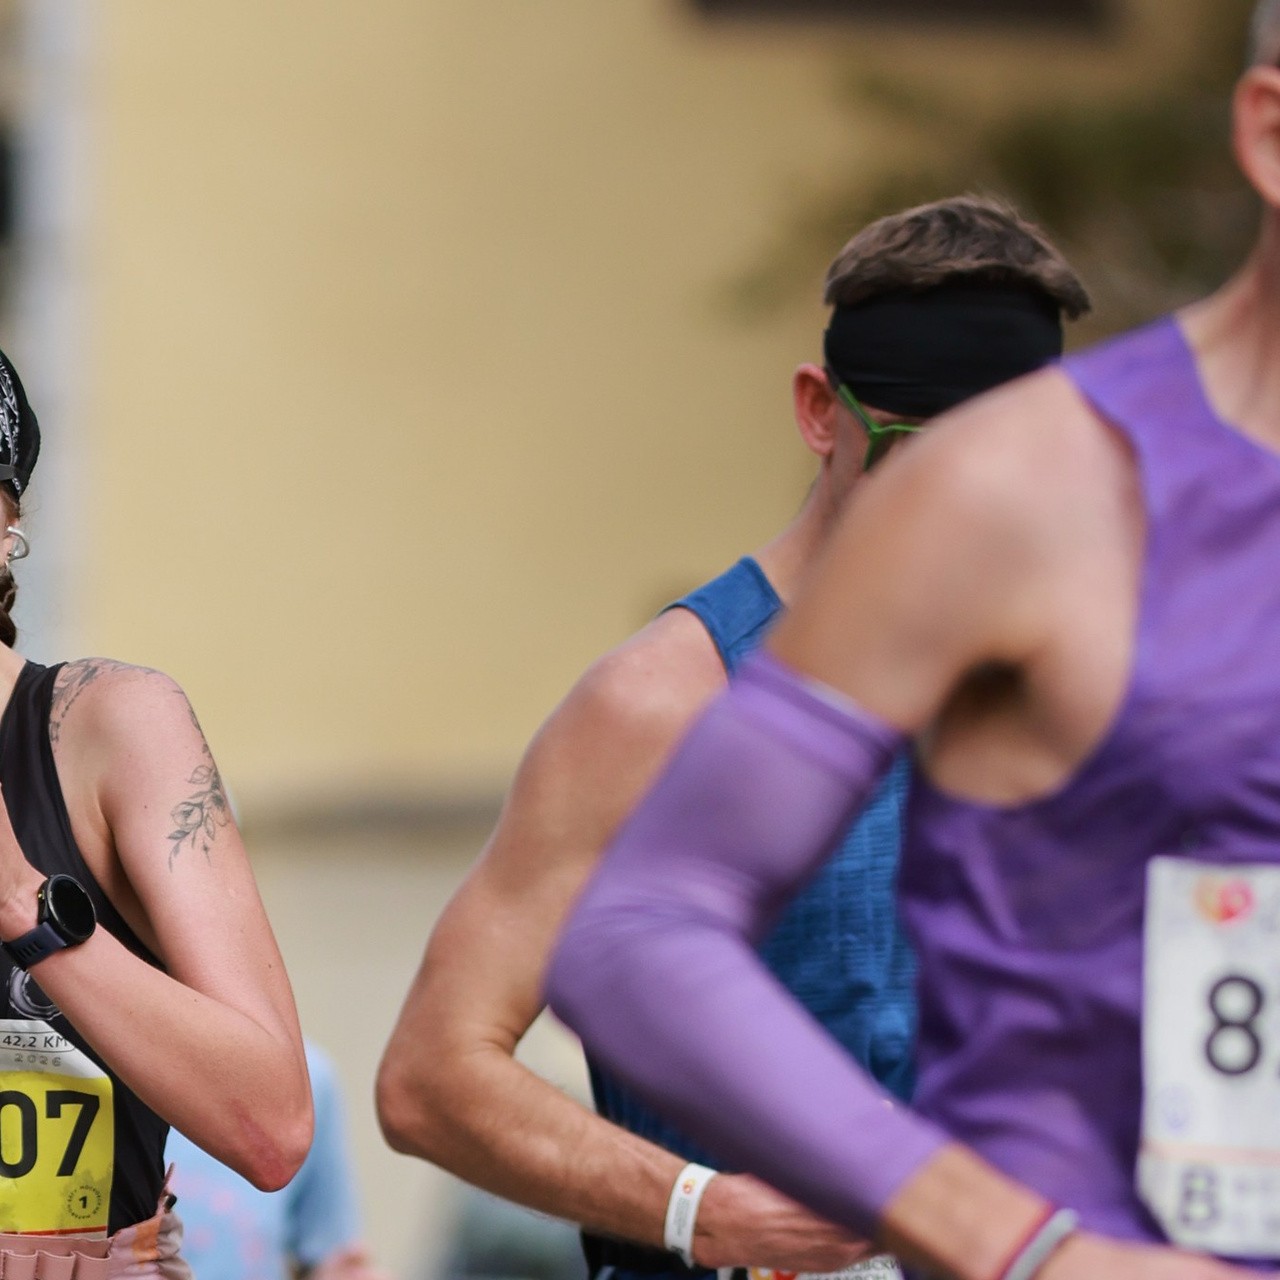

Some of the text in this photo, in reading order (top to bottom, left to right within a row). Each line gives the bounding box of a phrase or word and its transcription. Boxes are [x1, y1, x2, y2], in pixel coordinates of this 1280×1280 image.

[1205, 975, 1265, 1077] 8
[2, 1035, 69, 1049] 42,2 КМ
[14, 1053, 62, 1067] 2026
[78, 1195, 88, 1209] 1
